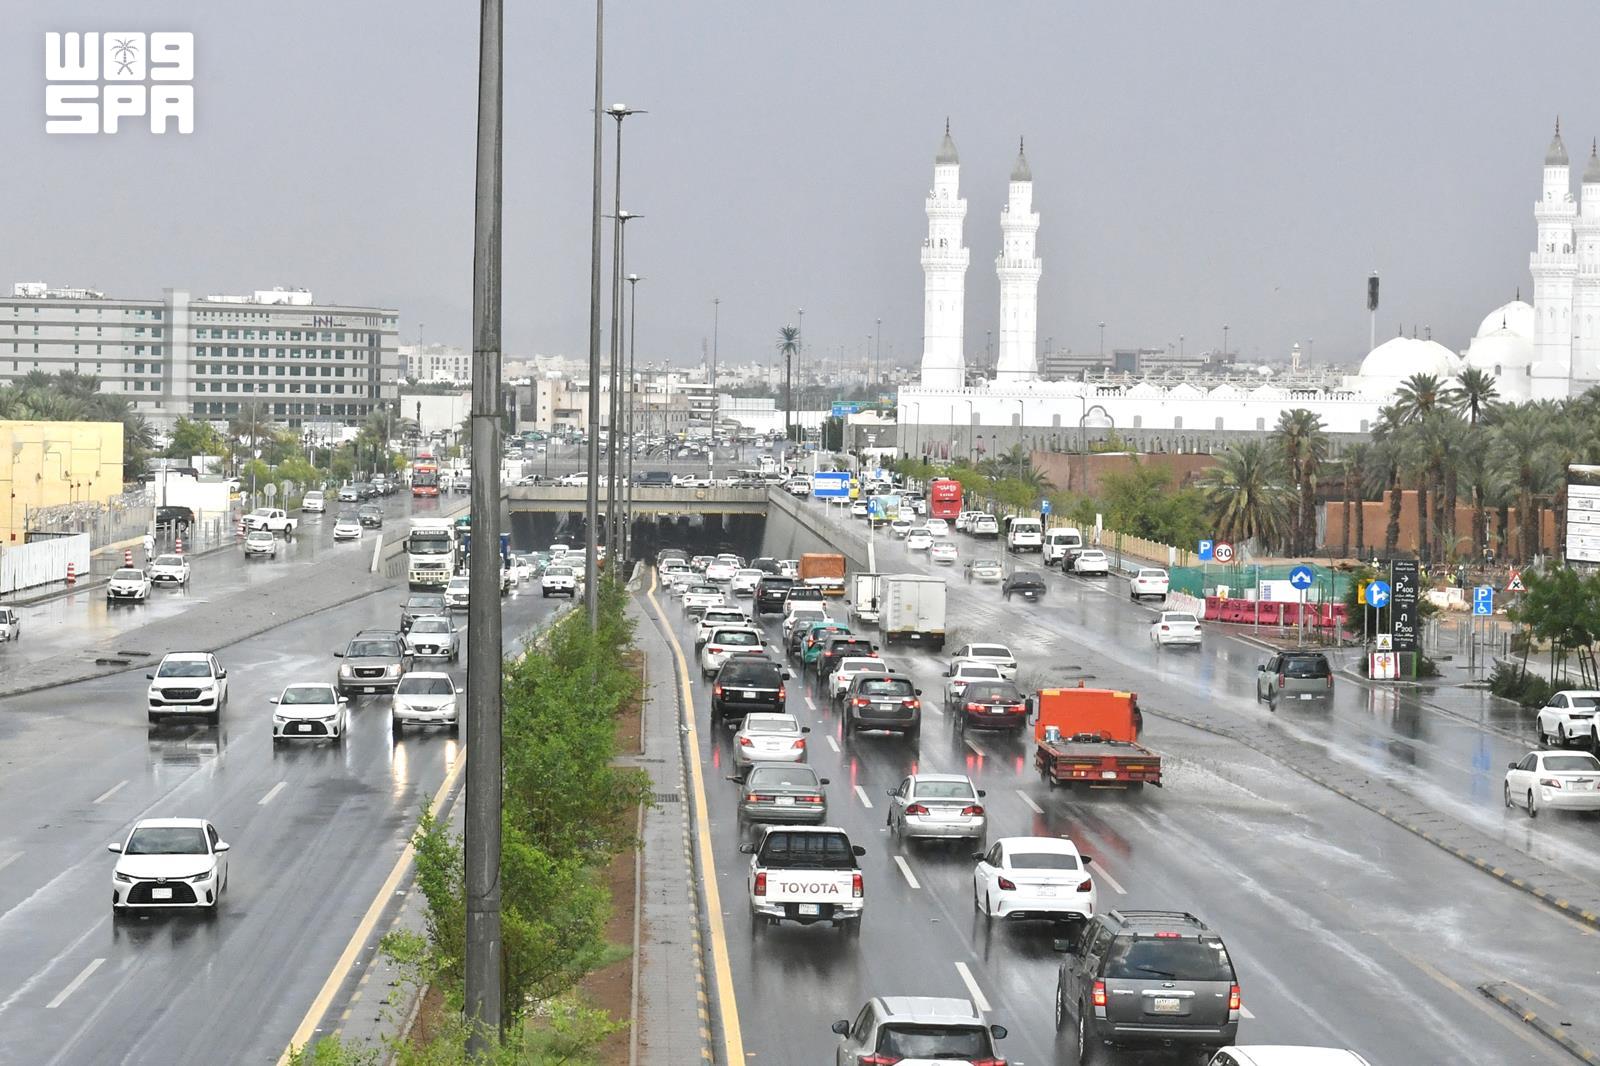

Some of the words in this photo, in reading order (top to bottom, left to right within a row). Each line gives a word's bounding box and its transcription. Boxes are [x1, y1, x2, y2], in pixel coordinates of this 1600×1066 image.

[1200, 542, 1210, 554] P
[1216, 548, 1232, 558] 60
[1478, 589, 1488, 600] P
[780, 882, 839, 894] TOYOTA
